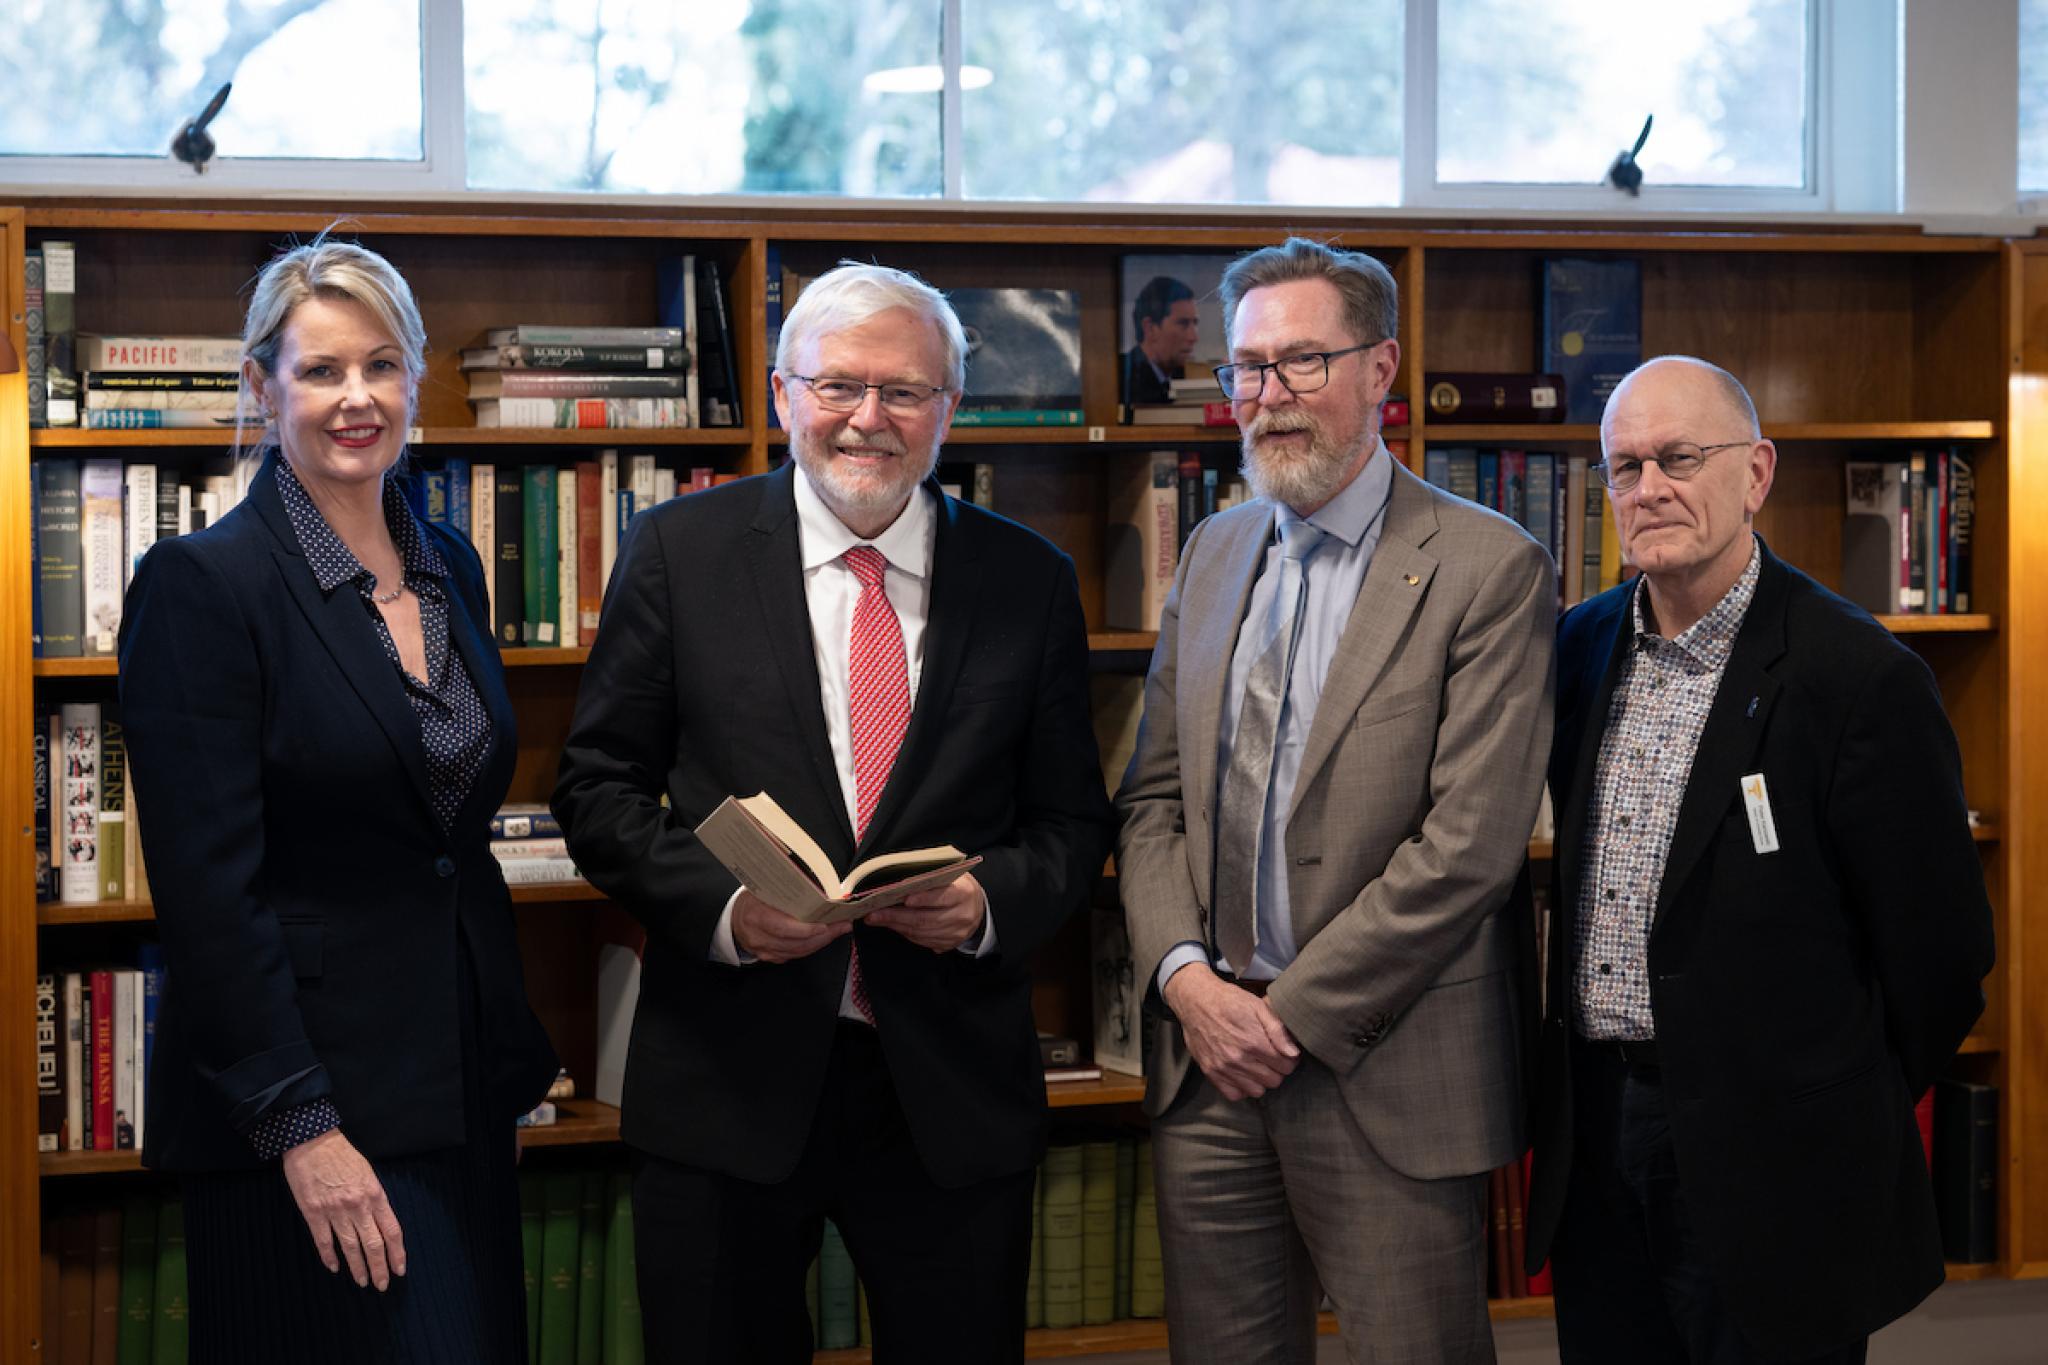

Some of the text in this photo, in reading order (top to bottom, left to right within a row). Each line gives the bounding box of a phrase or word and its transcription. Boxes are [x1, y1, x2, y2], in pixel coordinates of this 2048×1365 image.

[108, 346, 178, 365] PACIFIC
[138, 469, 149, 524] STEPHEN
[1157, 503, 1173, 578] EDWARDIANS
[34, 734, 47, 811] CLASSICAL
[103, 719, 124, 812] ATHENS
[37, 974, 57, 1088] RICHELIEU
[99, 1018, 111, 1105] THE HANSA
